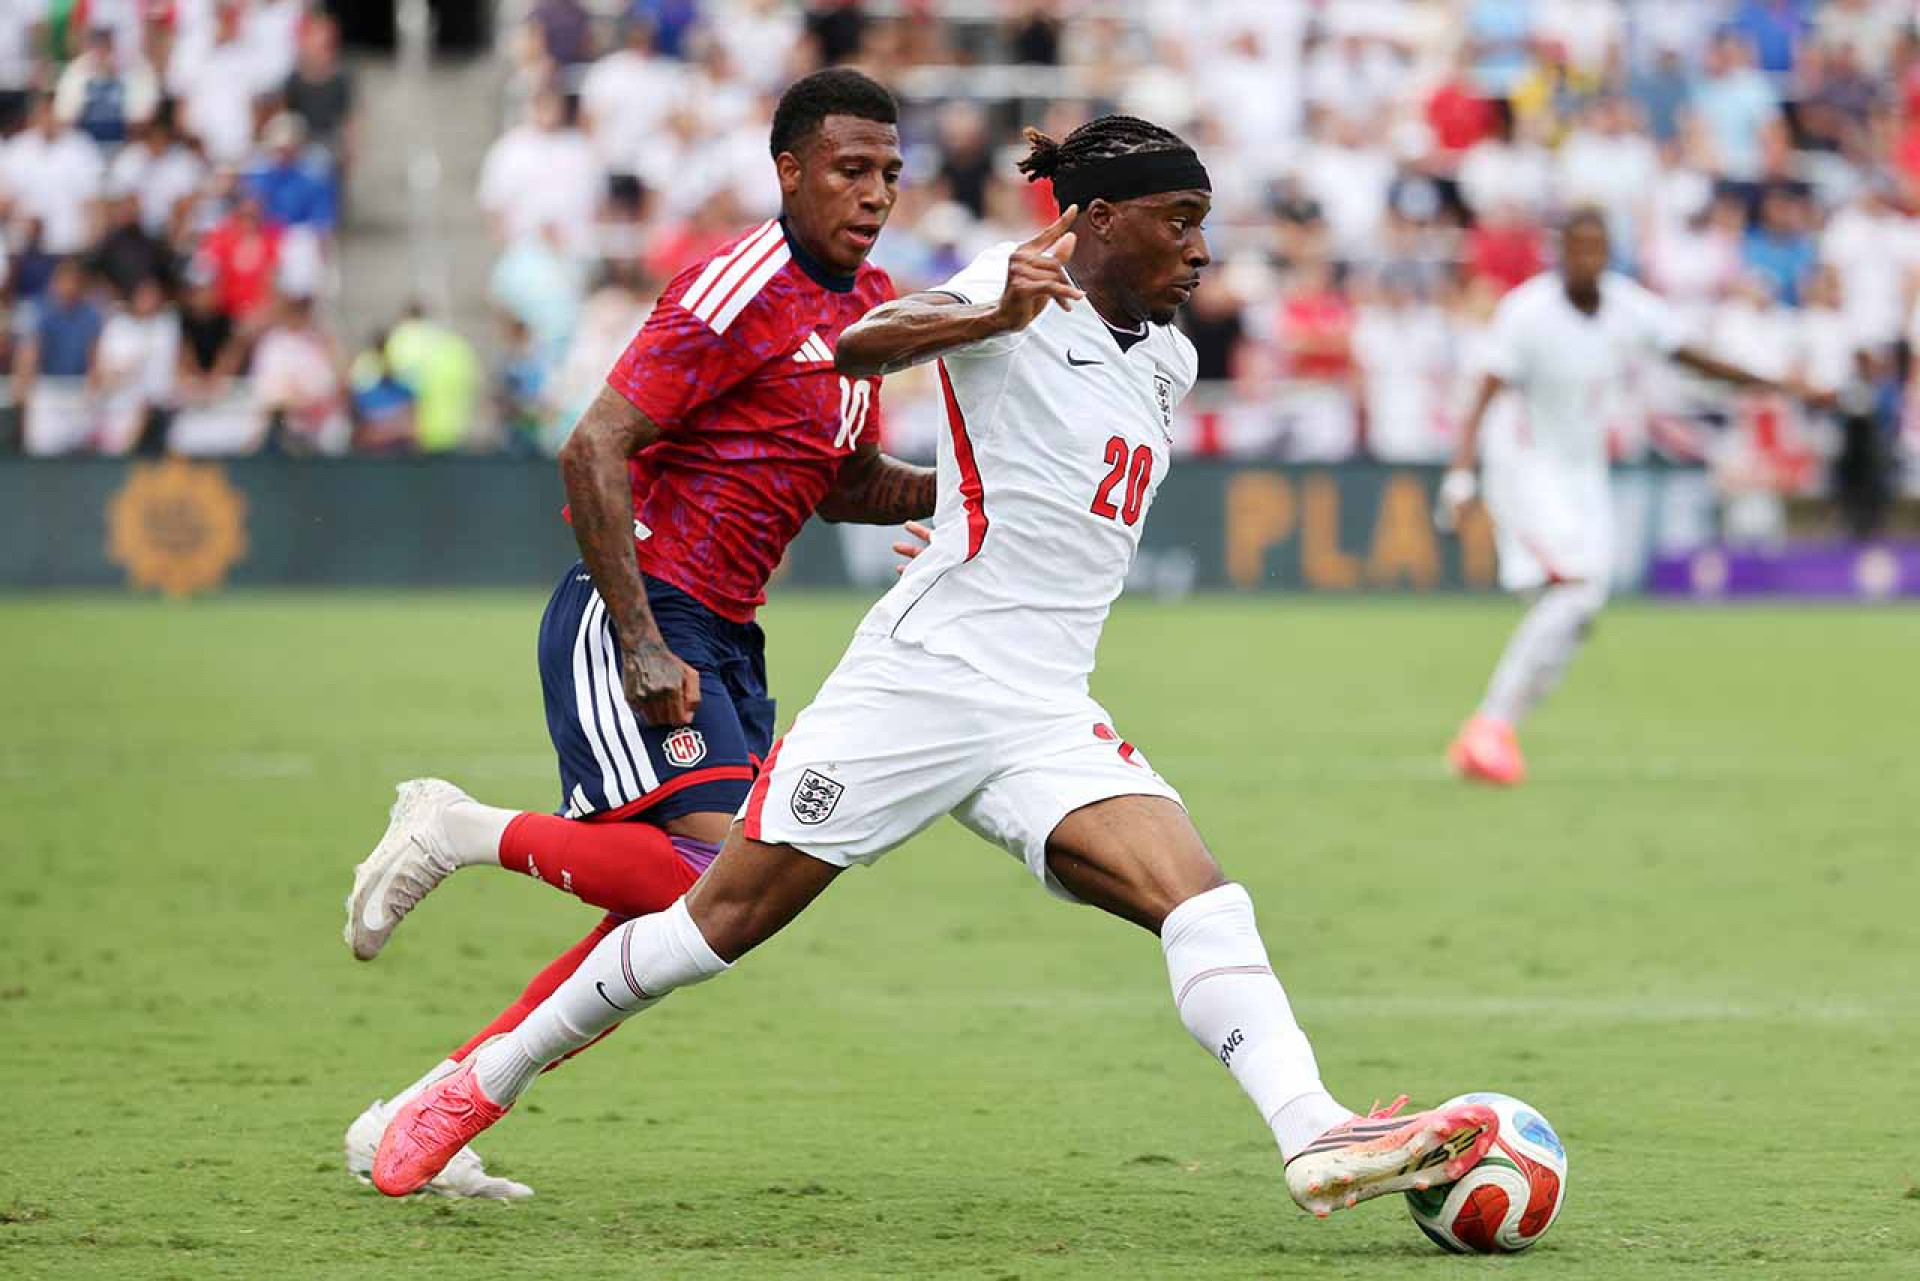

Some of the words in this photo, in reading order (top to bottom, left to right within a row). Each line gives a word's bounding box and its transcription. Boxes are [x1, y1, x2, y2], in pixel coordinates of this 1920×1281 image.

[834, 376, 871, 451] 10
[1090, 435, 1153, 526] 20
[671, 734, 697, 760] CR
